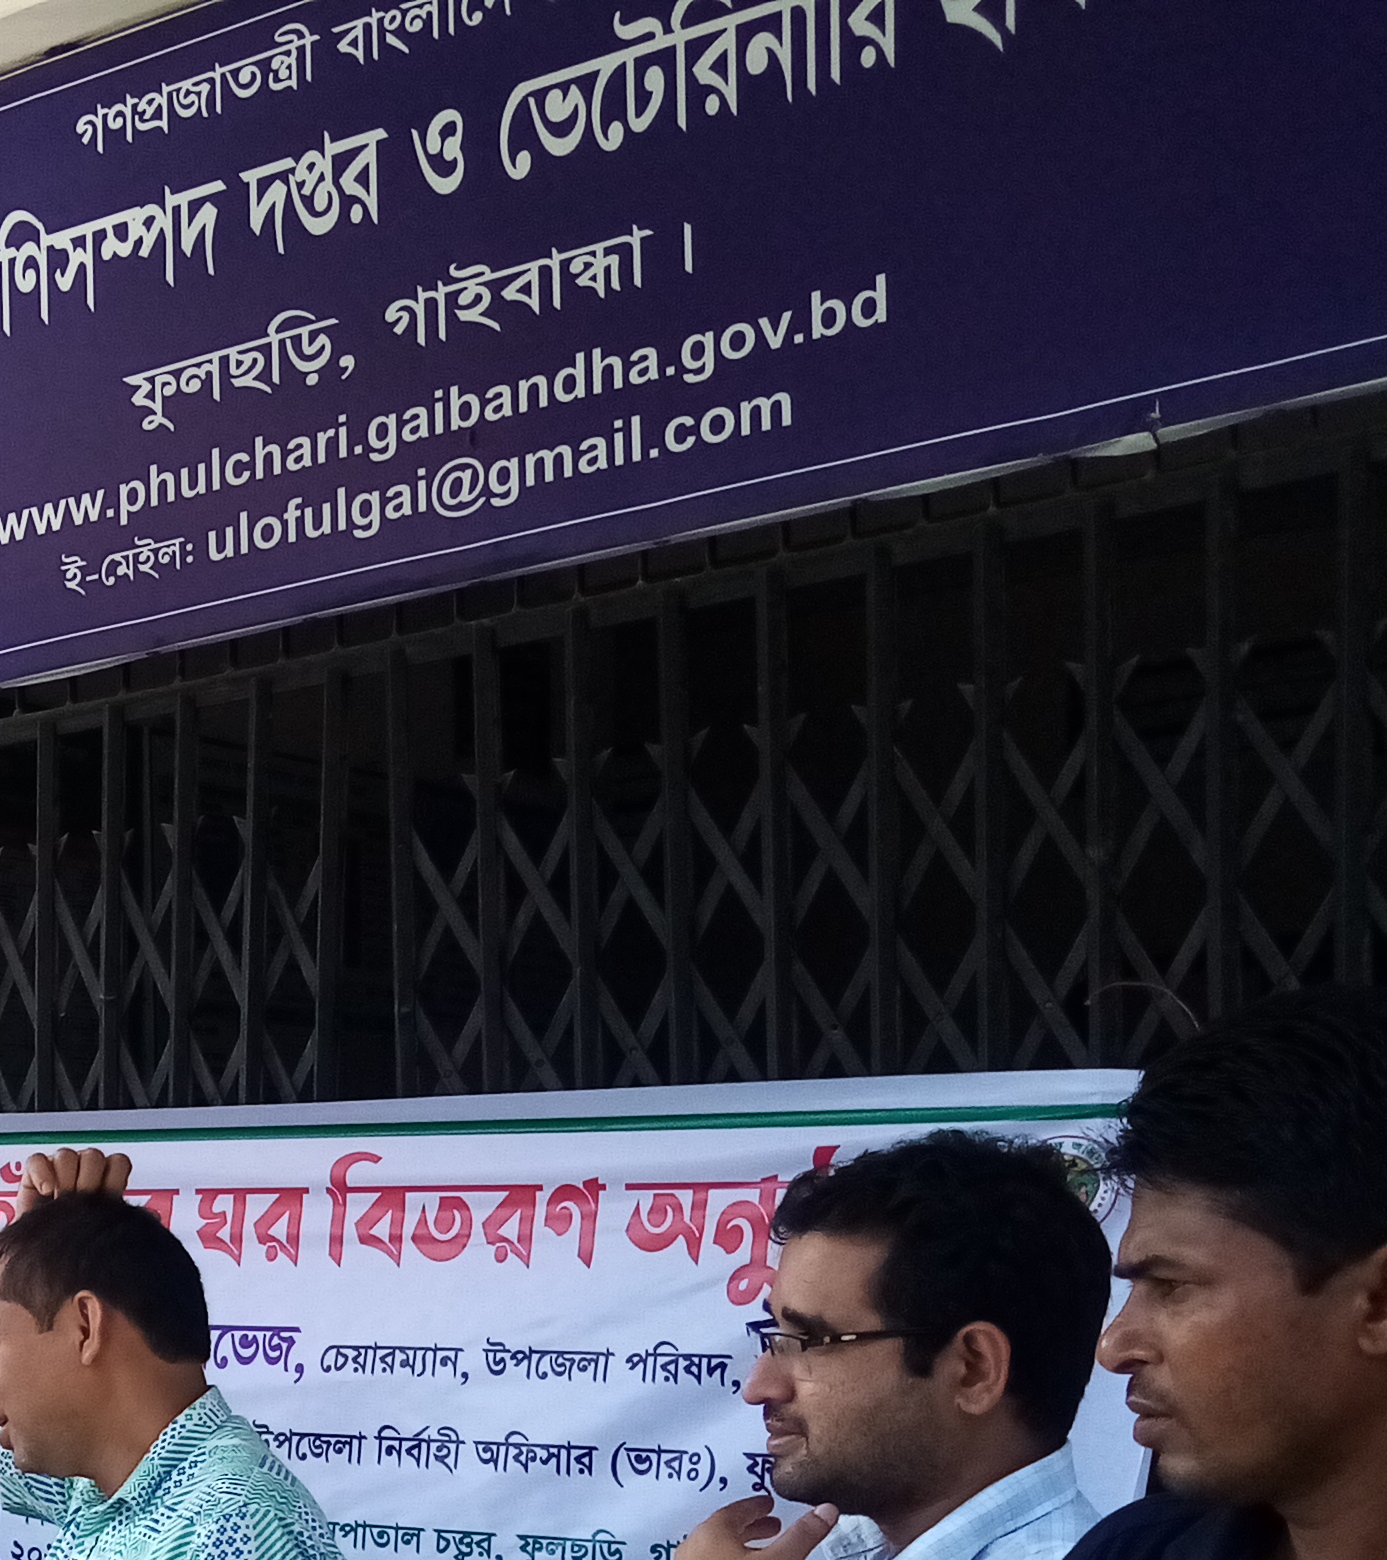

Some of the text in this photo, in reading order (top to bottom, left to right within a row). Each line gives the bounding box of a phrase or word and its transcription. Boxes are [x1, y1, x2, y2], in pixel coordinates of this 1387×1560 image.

[76, 22, 320, 154] গণপ্রজাতন্ত্রী
[239, 128, 388, 254] দপ্তর
[411, 109, 465, 195] ও
[122, 309, 356, 431] ফুলছড়ি,
[384, 224, 654, 347] গাইবান্ধা
[208, 391, 793, 562] ulofulgai@gmail.com
[194, 1185, 309, 1267] ঘর
[326, 1151, 607, 1268] বিতরণ
[320, 1341, 470, 1384] চেয়ারম্যান,
[482, 1337, 615, 1384] উপজেলা
[625, 1341, 742, 1395] পরিষদ,
[375, 1424, 466, 1473] নির্বাহী
[474, 1431, 599, 1477] অফিসার
